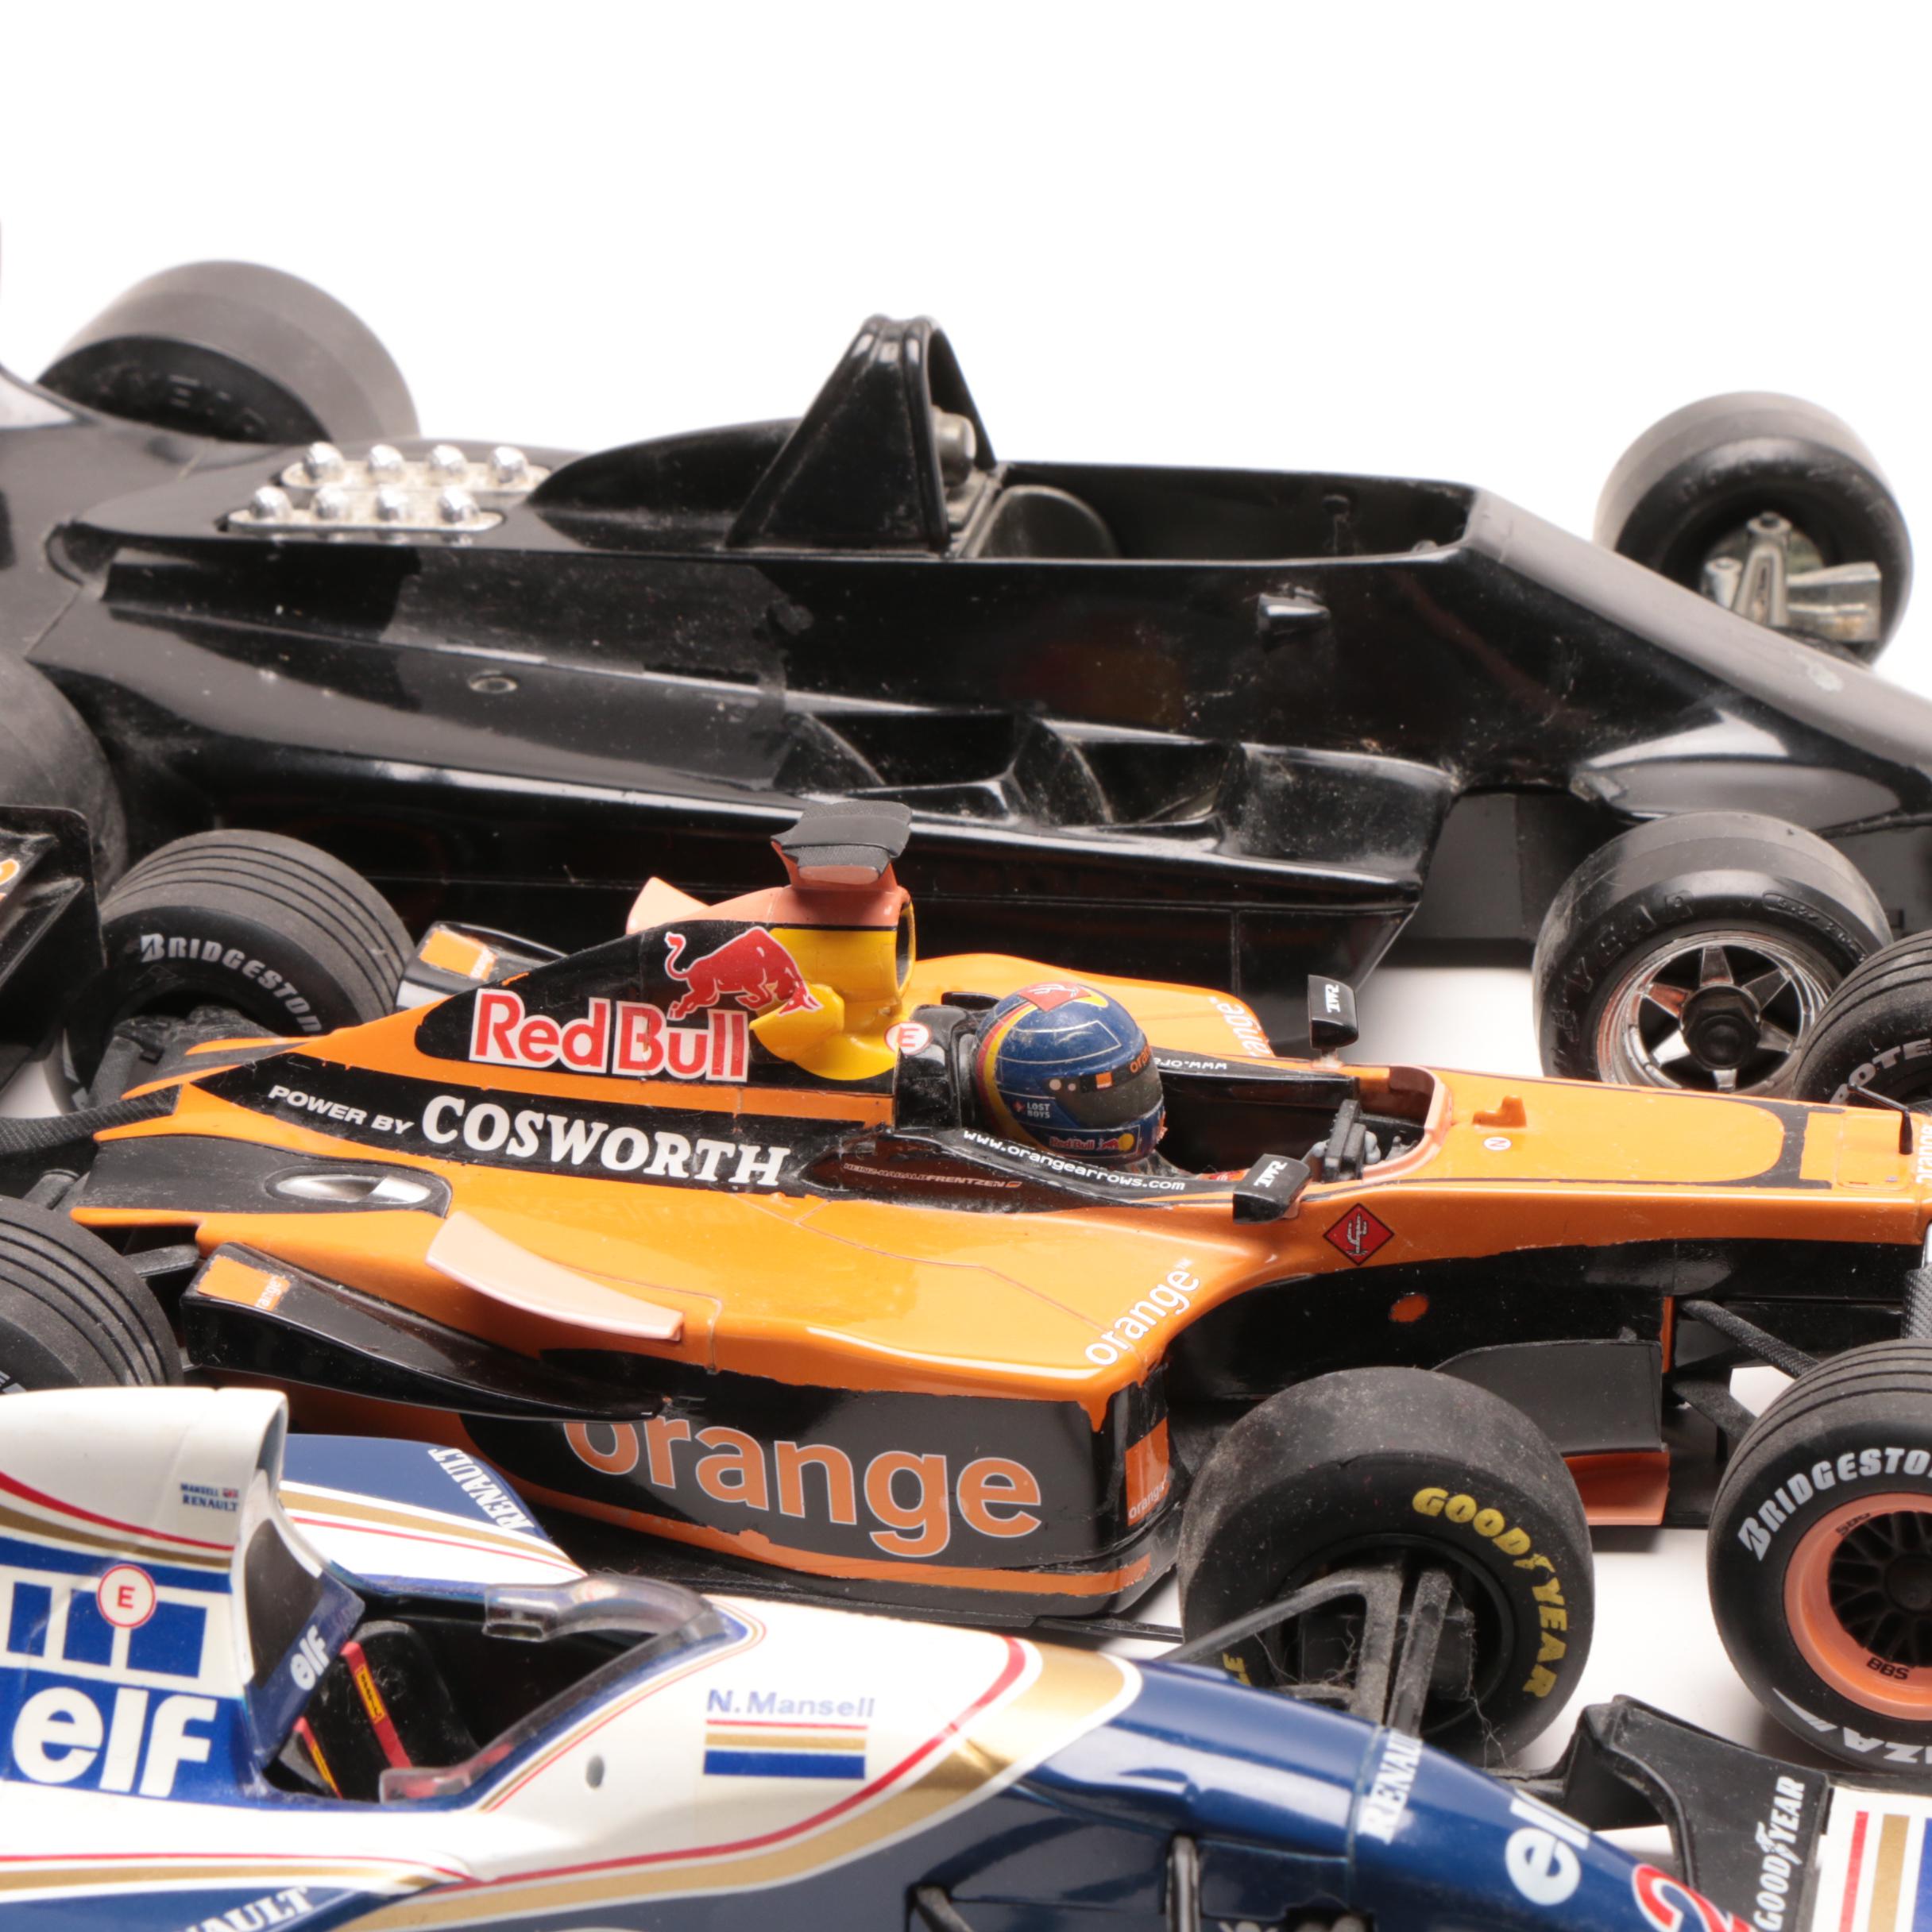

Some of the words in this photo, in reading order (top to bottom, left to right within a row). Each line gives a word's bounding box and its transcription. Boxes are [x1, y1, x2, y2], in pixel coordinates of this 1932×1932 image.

[469, 988, 610, 1074] Red
[612, 1000, 749, 1083] Bull
[268, 1085, 368, 1125] POWER
[371, 1115, 415, 1134] BY
[422, 1095, 790, 1187] COSWORTH
[1026, 1102, 1051, 1112] LOST
[964, 1130, 1185, 1191] www.orangearrows.com
[1084, 1269, 1200, 1366] orange
[182, 1493, 239, 1513] RENAULT
[427, 1447, 535, 1530] RENAULT
[563, 1414, 1041, 1558] orange
[1737, 1447, 1932, 1561] BRIDGESTO
[290, 1625, 330, 1690] elf
[1867, 1656, 1911, 1680] BBS
[12, 1687, 217, 1799] elf
[184, 1885, 313, 1932] AULT
